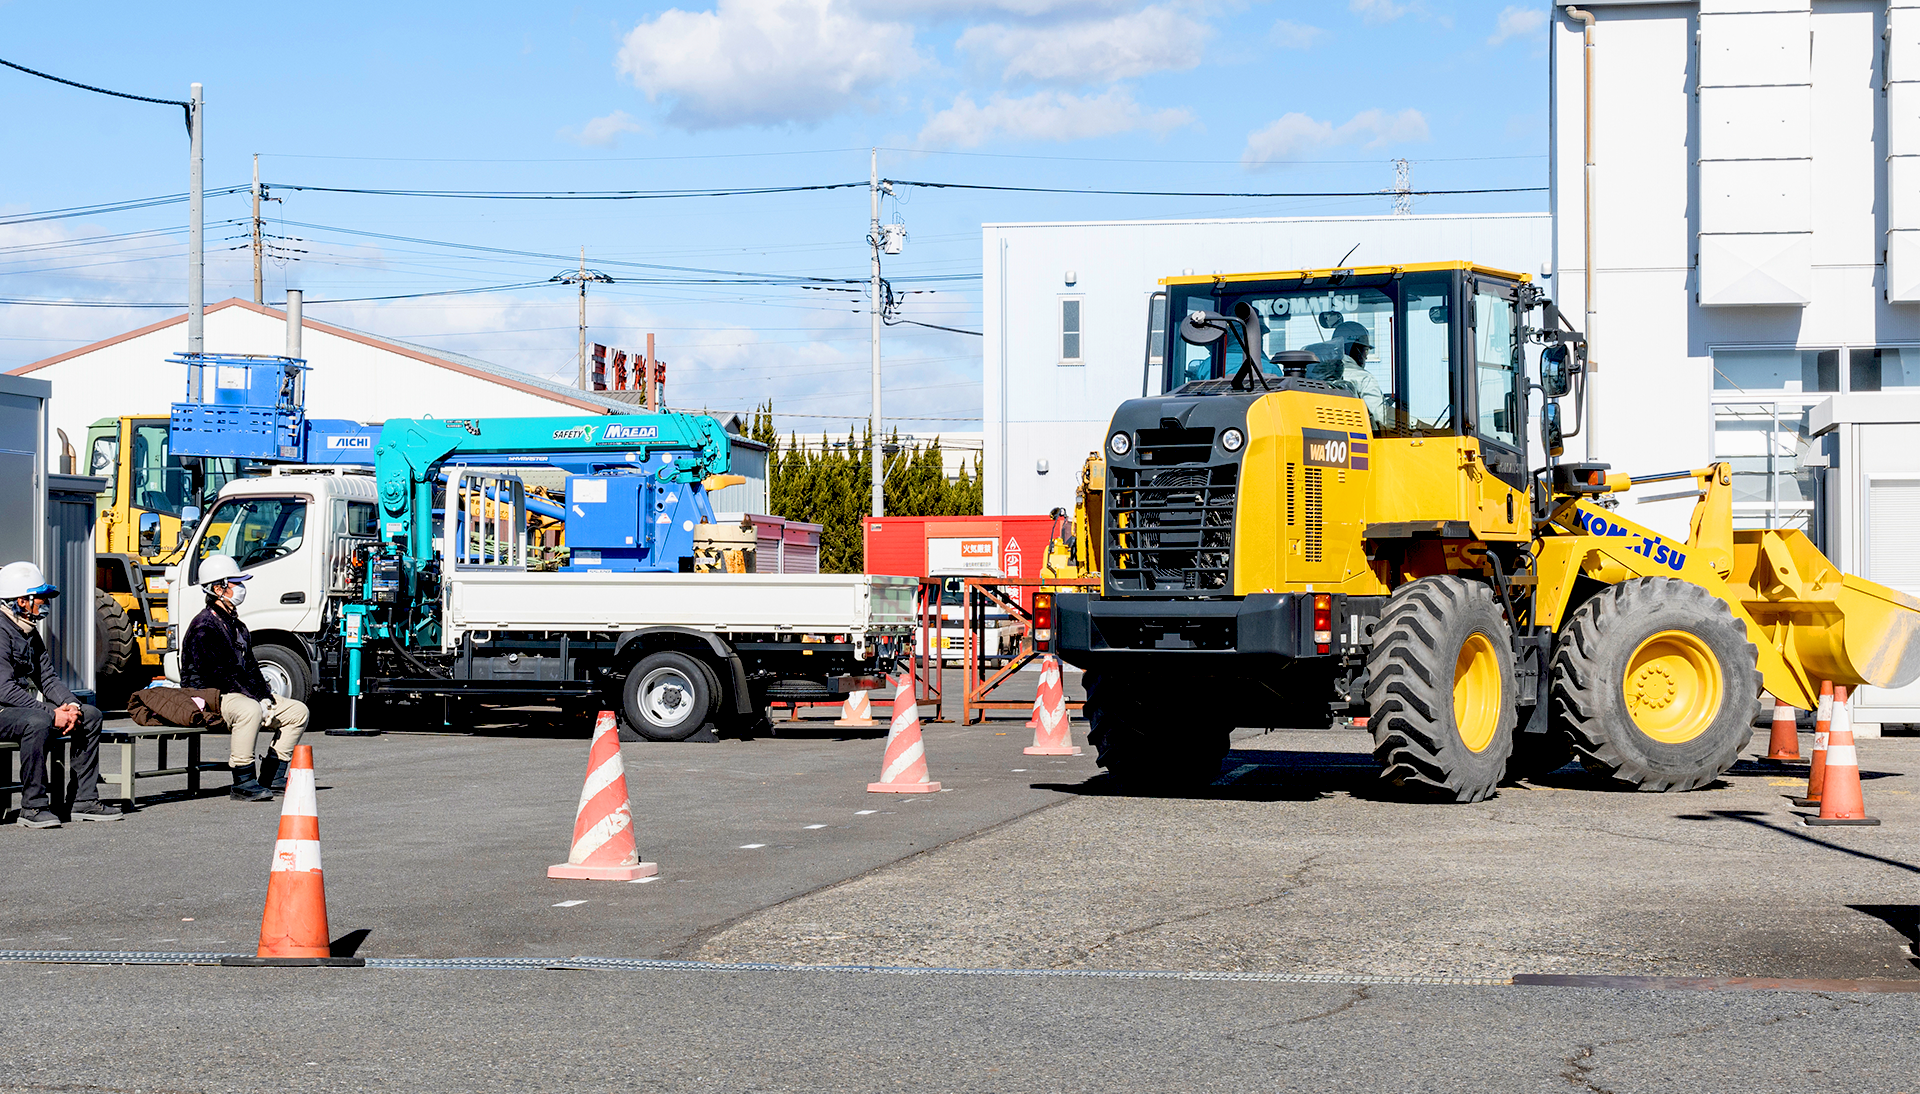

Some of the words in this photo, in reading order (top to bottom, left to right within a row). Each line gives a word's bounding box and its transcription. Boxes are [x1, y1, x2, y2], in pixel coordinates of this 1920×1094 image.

[1252, 291, 1359, 315] KOMATSU
[553, 430, 584, 439] SAFETY
[605, 425, 656, 438] MAEDA
[335, 438, 368, 447] AICHI
[1310, 440, 1347, 463] WA100
